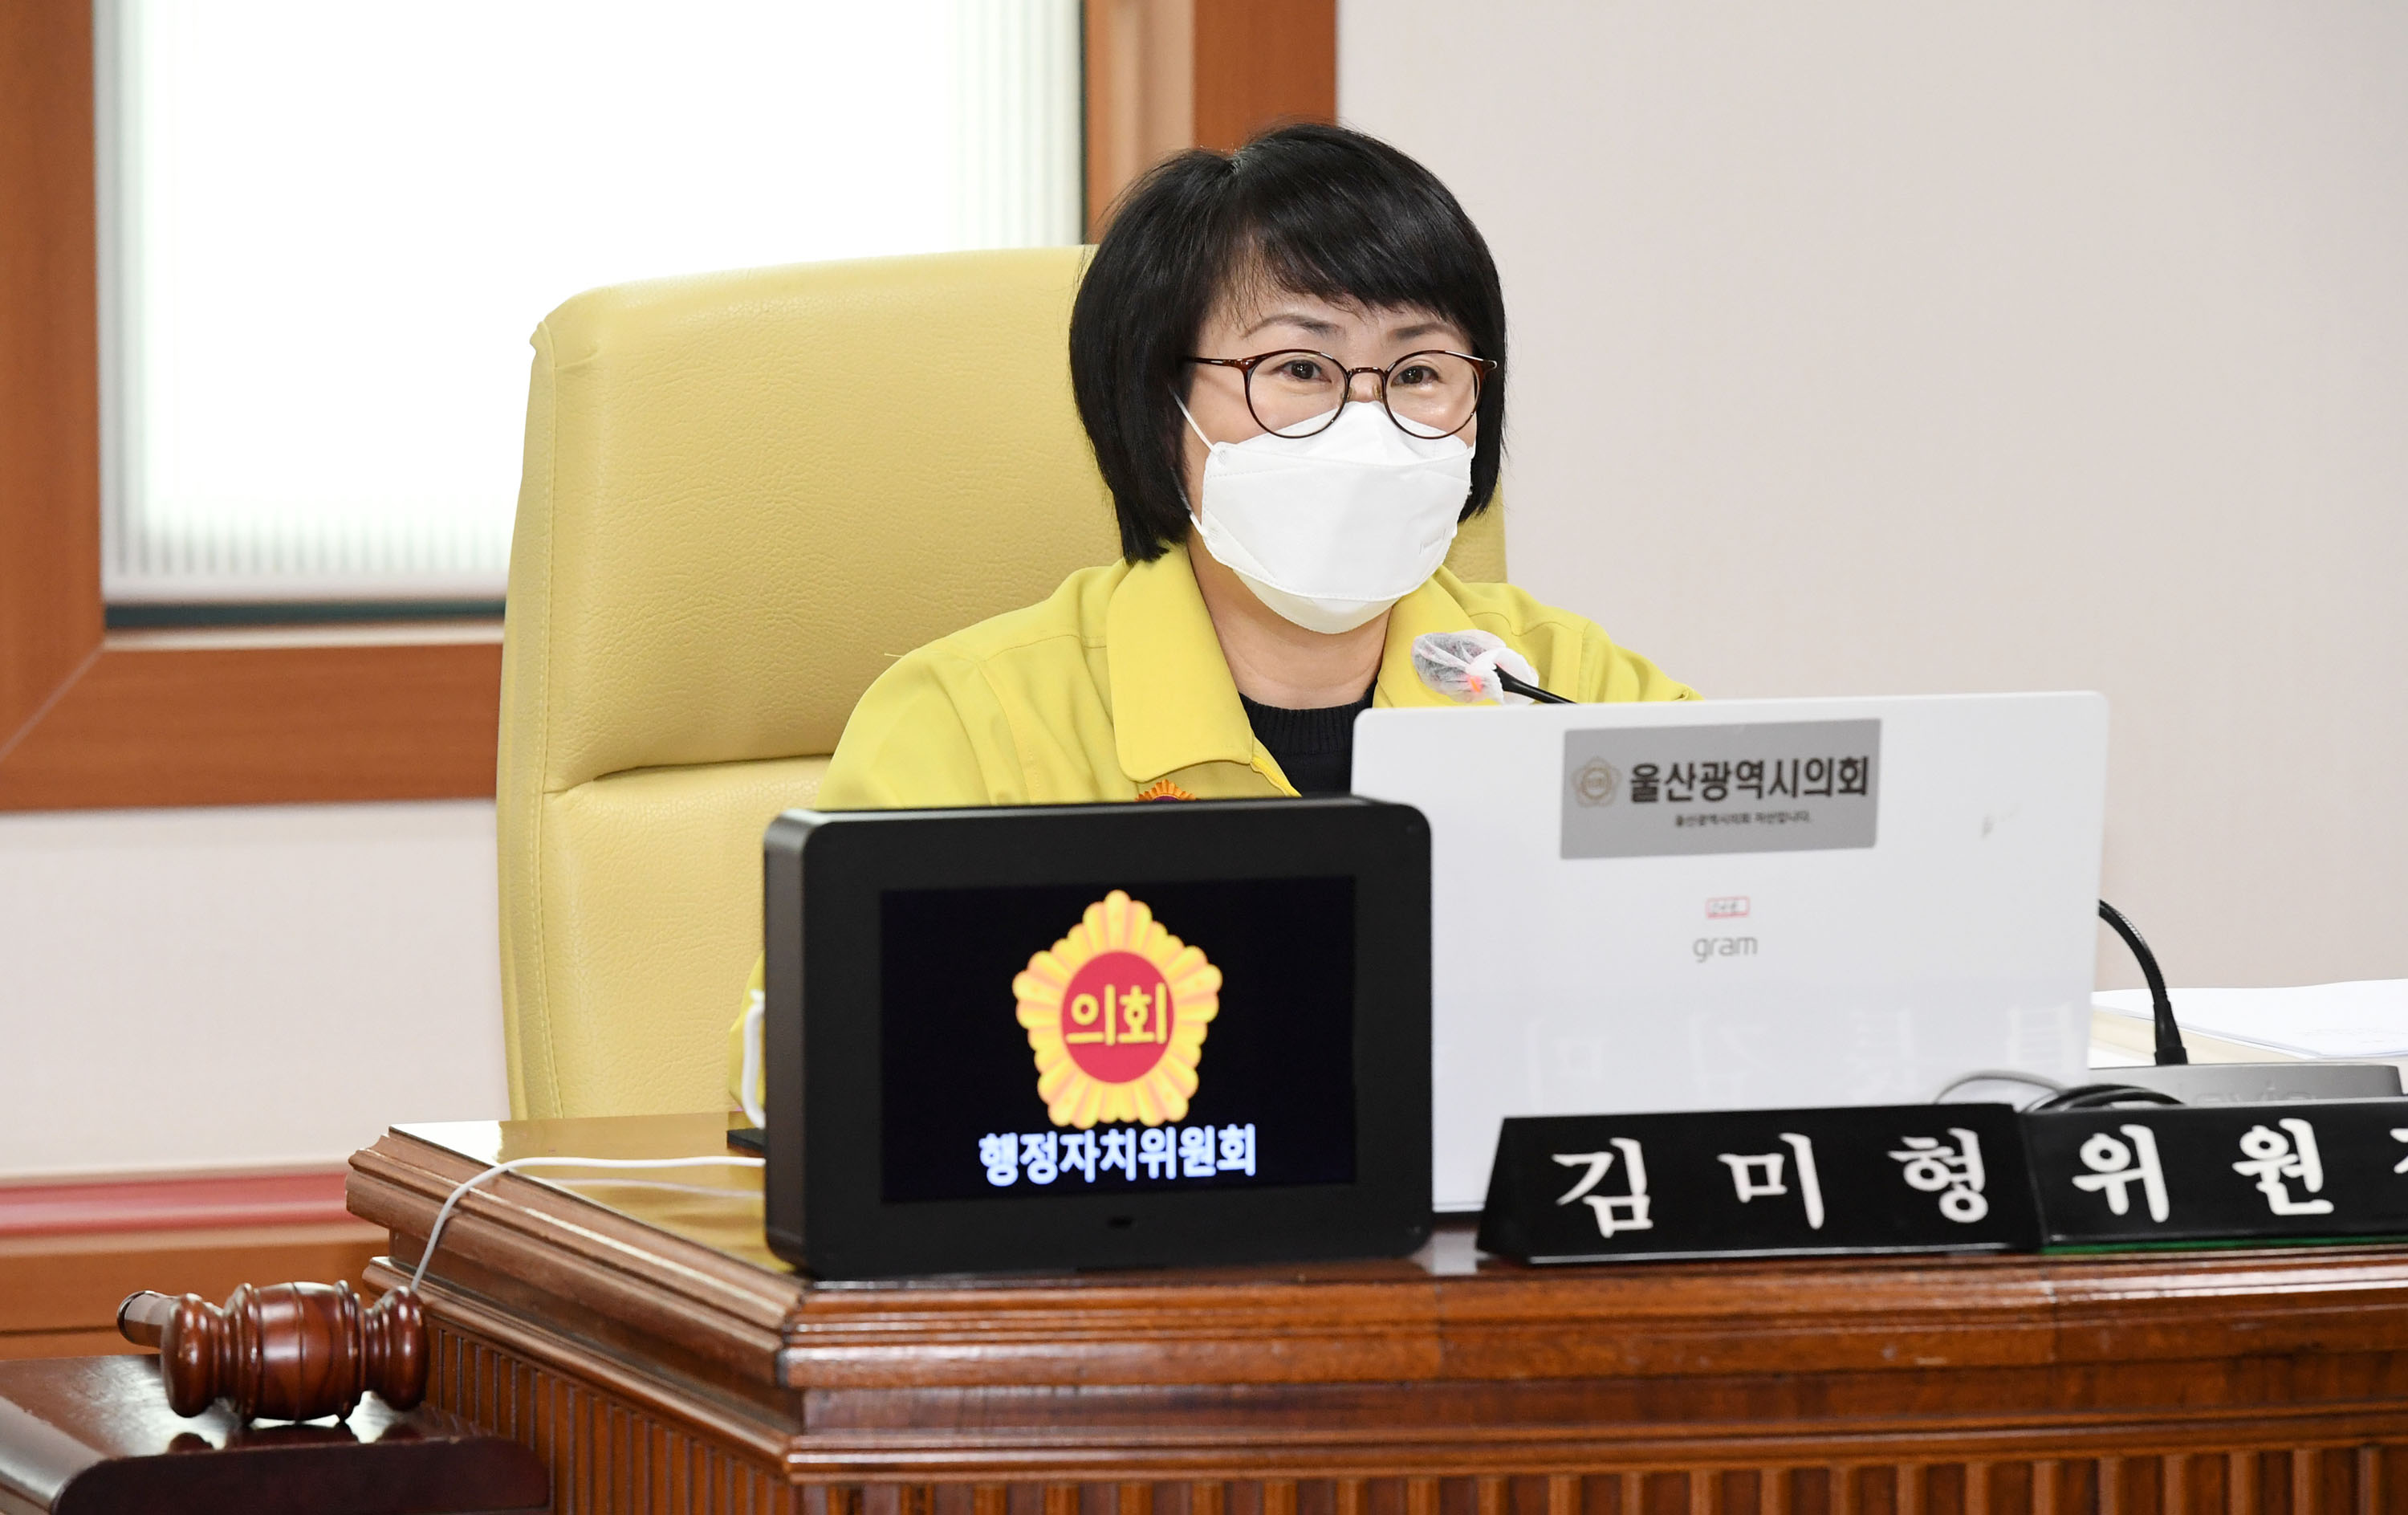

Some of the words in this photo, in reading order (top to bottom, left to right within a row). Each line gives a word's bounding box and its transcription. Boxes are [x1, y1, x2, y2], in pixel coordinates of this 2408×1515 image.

[1630, 755, 1869, 804] 울산광역시의회
[1693, 935, 1758, 963] gram
[1065, 982, 1168, 1046] 의회
[978, 1123, 1257, 1187] 행정자치위원회
[2072, 1118, 2408, 1223] 위원
